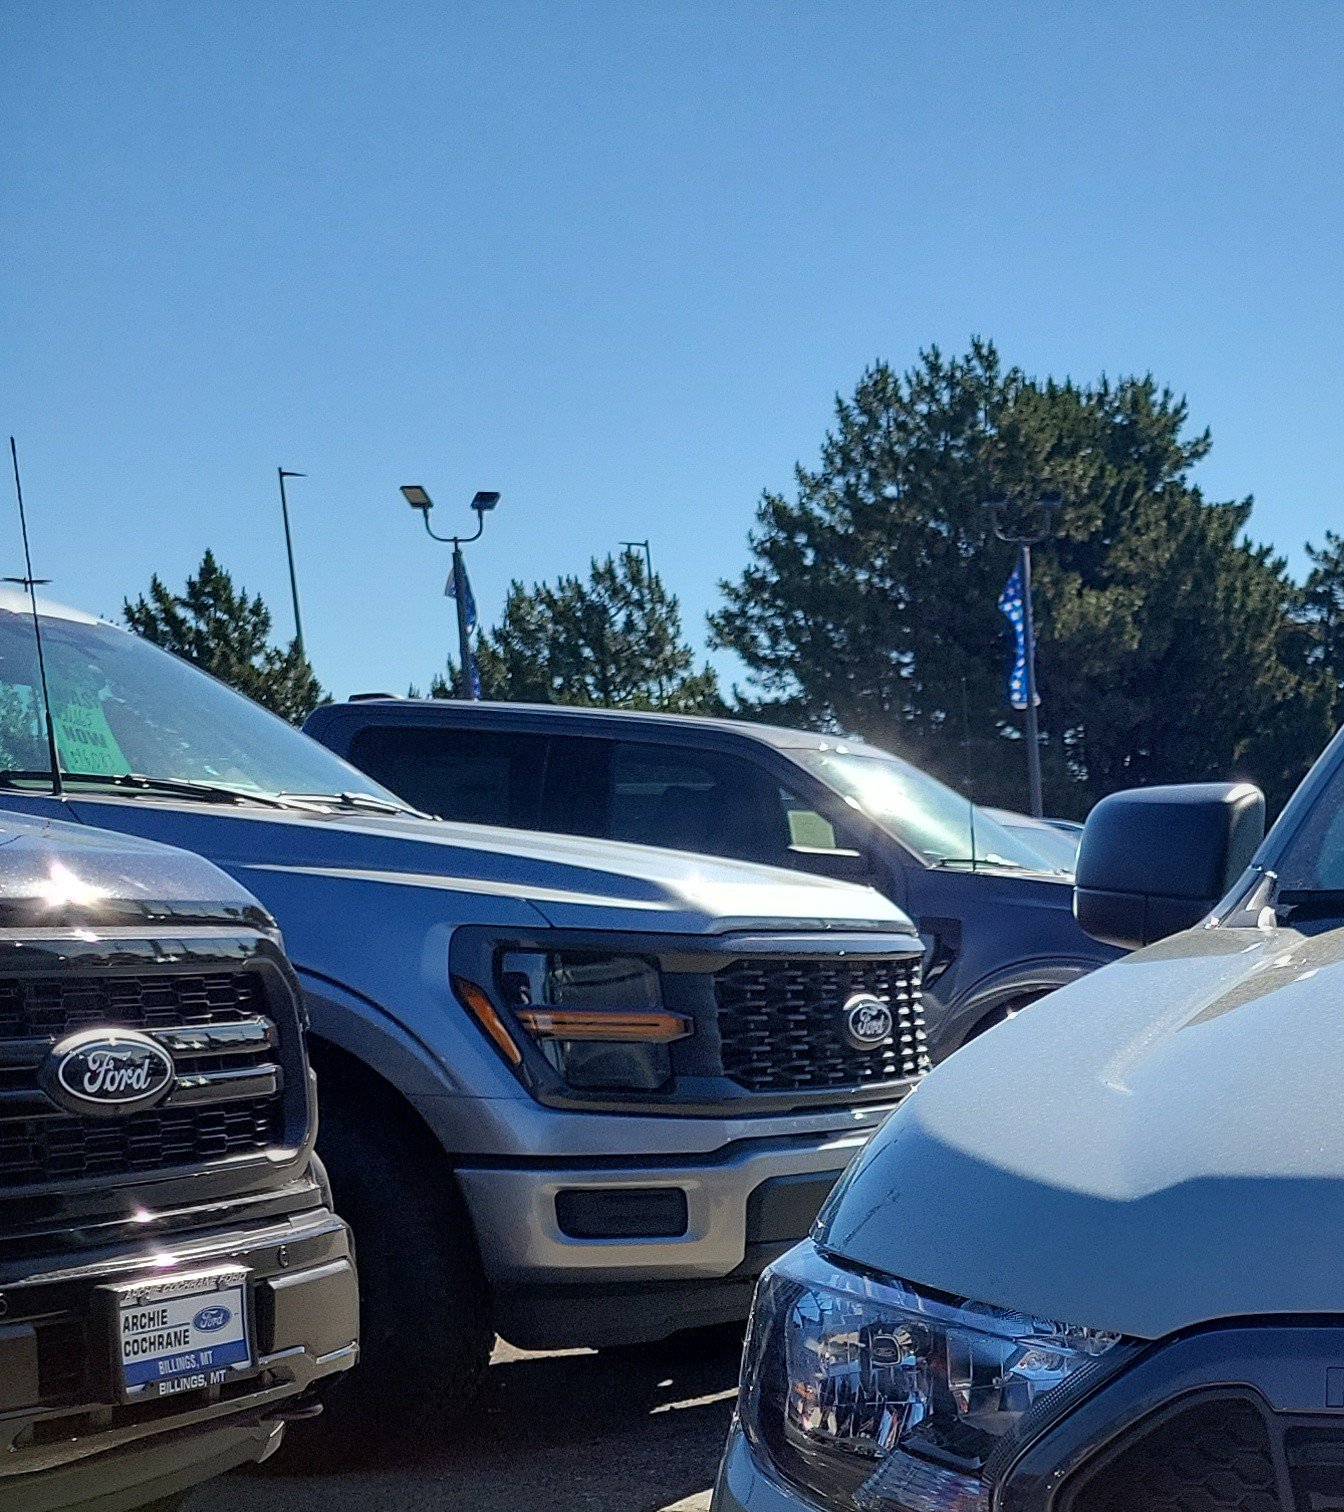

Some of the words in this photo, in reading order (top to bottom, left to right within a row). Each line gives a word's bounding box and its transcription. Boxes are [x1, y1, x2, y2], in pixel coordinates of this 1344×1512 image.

[858, 1007, 885, 1035] Ford
[83, 1050, 150, 1093] Ford
[122, 1309, 168, 1333] ARCHIE
[200, 1310, 224, 1328] Ford
[123, 1328, 190, 1357] COCHRANE
[158, 1355, 200, 1375] BILLINGS,
[201, 1350, 214, 1365] MT
[159, 1374, 208, 1395] BILLINGS,
[210, 1369, 227, 1384] MT
